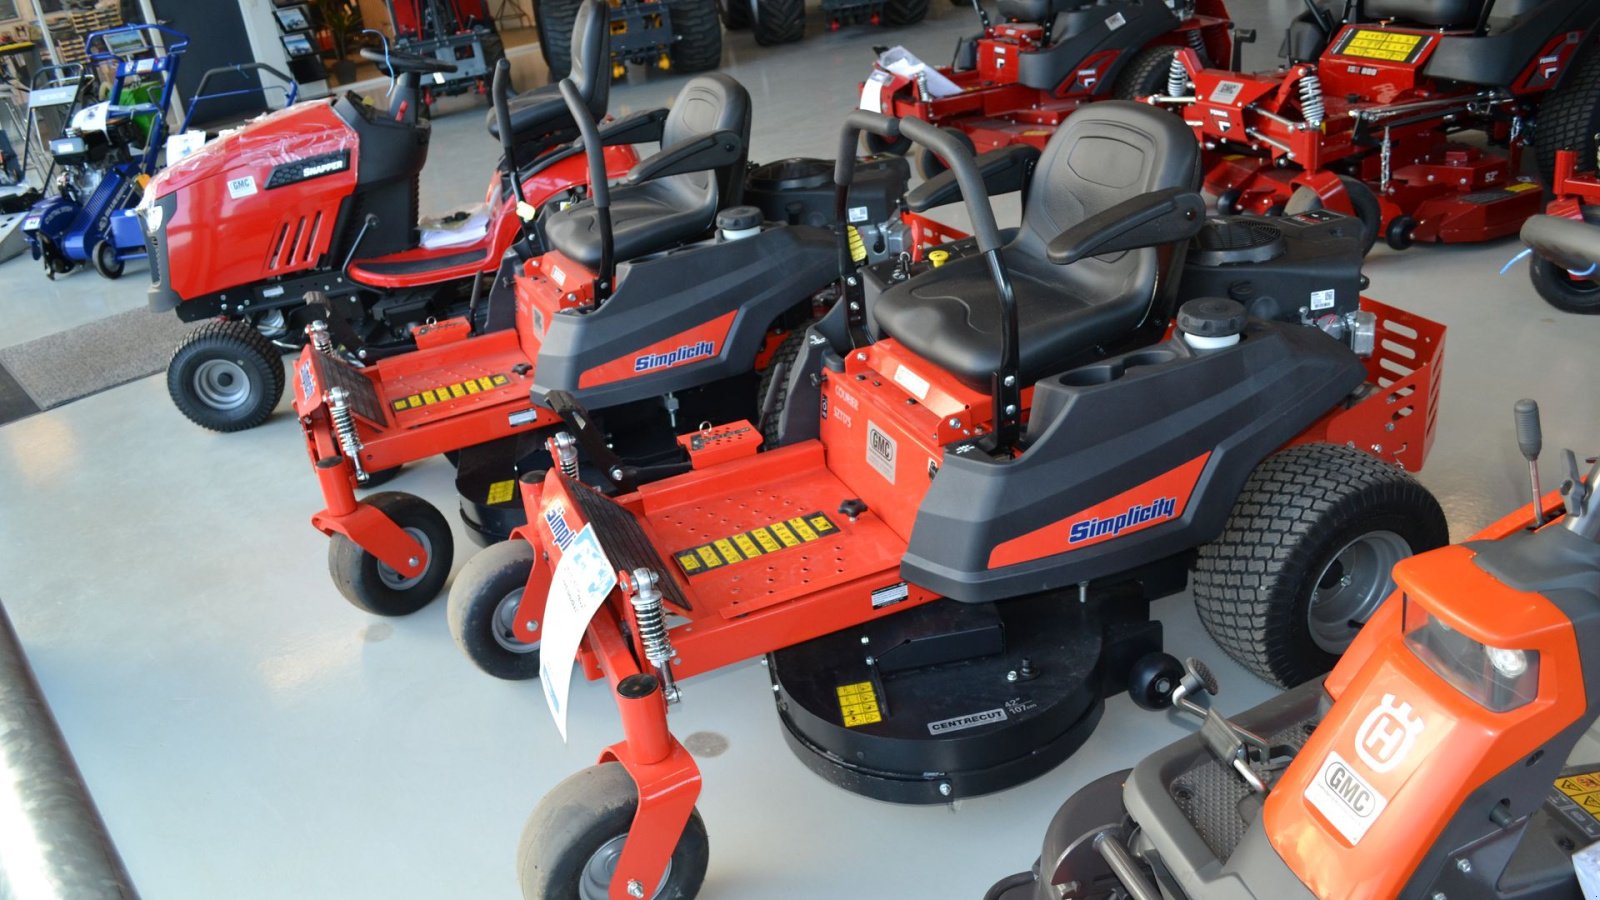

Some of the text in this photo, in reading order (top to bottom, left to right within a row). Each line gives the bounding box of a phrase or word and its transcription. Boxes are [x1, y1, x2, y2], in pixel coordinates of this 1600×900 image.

[303, 159, 344, 177] SNAPPER
[232, 178, 250, 191] GMC
[635, 341, 715, 371] Simplicity
[872, 432, 891, 458] GMC
[546, 507, 576, 552] Simpli
[1069, 496, 1176, 543] Simplicity
[931, 710, 1003, 731] CENTRECUT
[1329, 766, 1371, 813] GMC
